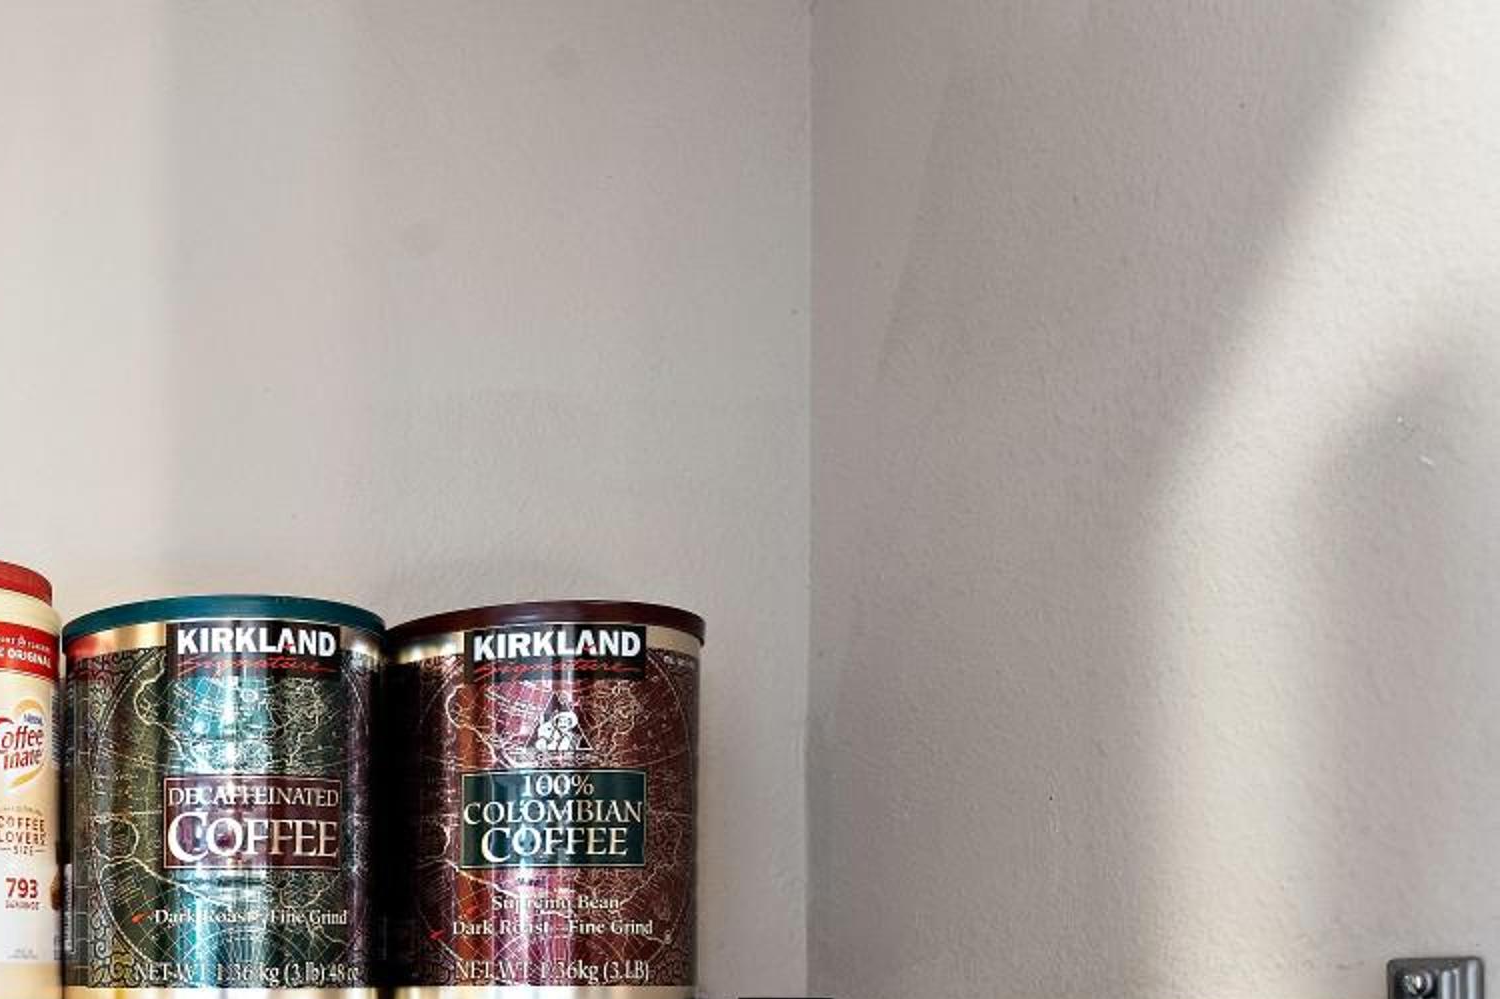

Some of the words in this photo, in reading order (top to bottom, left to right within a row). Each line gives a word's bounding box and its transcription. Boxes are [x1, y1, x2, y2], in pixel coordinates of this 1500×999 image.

[177, 626, 337, 658] KIRKLAND
[473, 629, 642, 663] KIRKLAND
[168, 786, 340, 808] DECAFFEINATED
[521, 773, 595, 798] 100%
[463, 799, 643, 825] COLOMBIAN
[167, 811, 340, 863] COFFEE
[481, 826, 629, 863] COFFEE
[5, 877, 38, 899] 793
[577, 894, 621, 910] Bean
[154, 908, 196, 926] Dark
[309, 909, 348, 926] Grind
[453, 920, 494, 936] Dark
[500, 920, 549, 936] Roast
[569, 919, 605, 935] Fine
[610, 919, 653, 935] Grind
